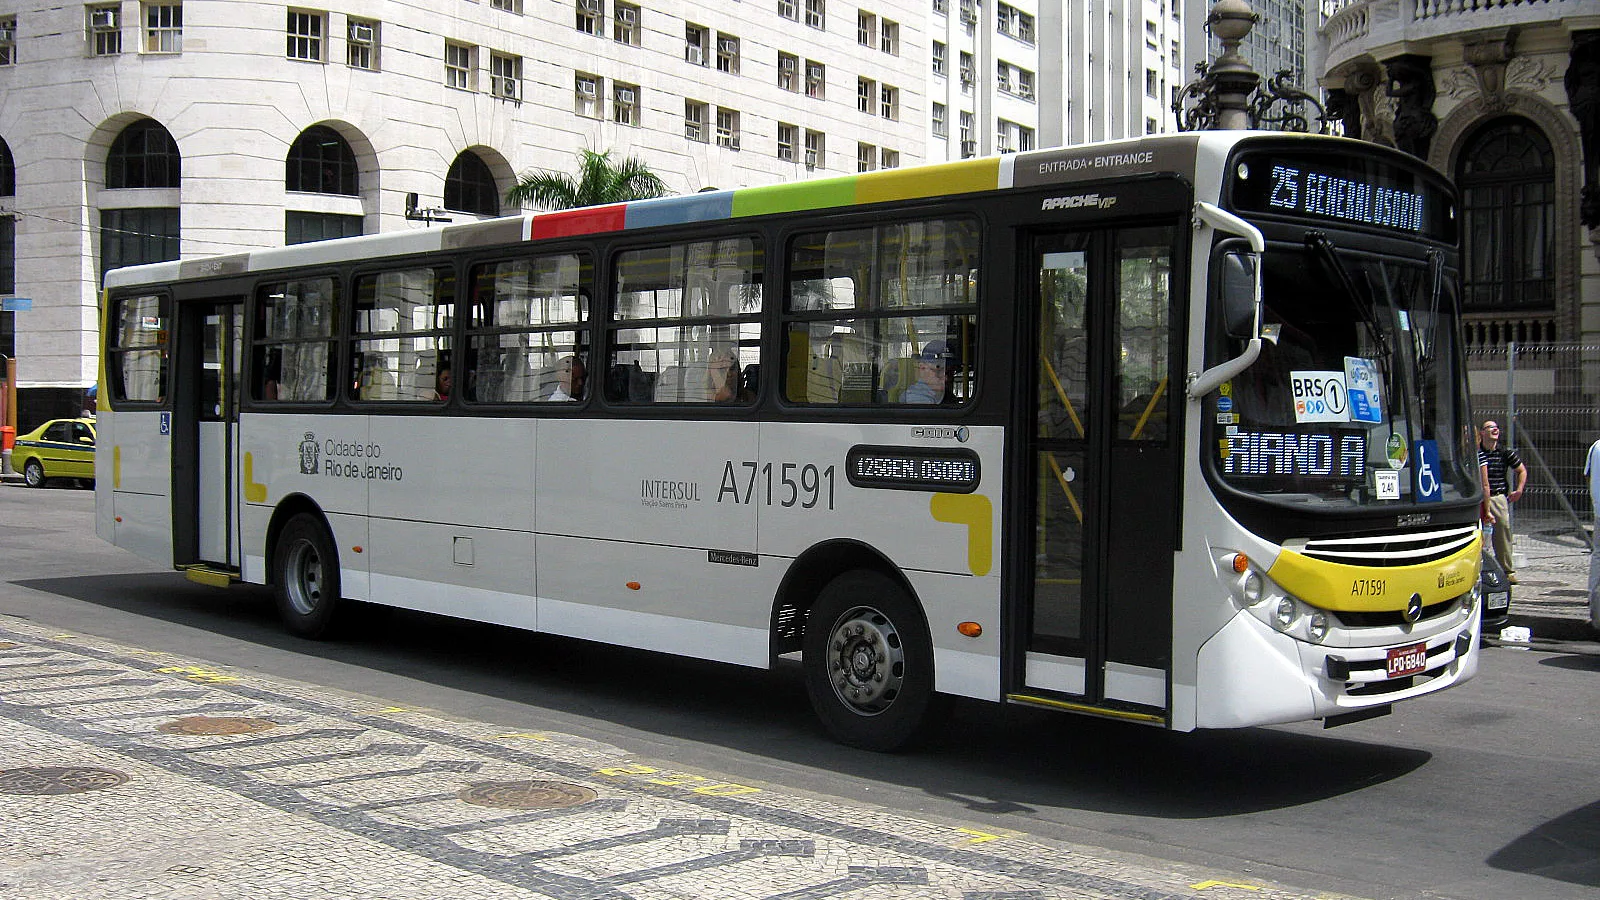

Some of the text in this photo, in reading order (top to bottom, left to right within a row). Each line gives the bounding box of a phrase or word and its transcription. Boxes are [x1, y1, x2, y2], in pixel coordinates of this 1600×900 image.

[1039, 151, 1153, 174] ENTRADA ENTRANCE
[1041, 194, 1117, 210] APACHE VIP
[1305, 172, 1372, 222] GENERAL
[1293, 378, 1323, 397] BRS
[1330, 384, 1338, 409] 1
[911, 427, 955, 438] CAIO
[325, 439, 381, 458] Cidade do
[325, 460, 402, 481] Rio de Janeiro
[641, 479, 701, 501] INTERSUL
[717, 460, 835, 510] A71591
[710, 551, 758, 565] Mercedes-Benz
[1351, 579, 1386, 596] A71591
